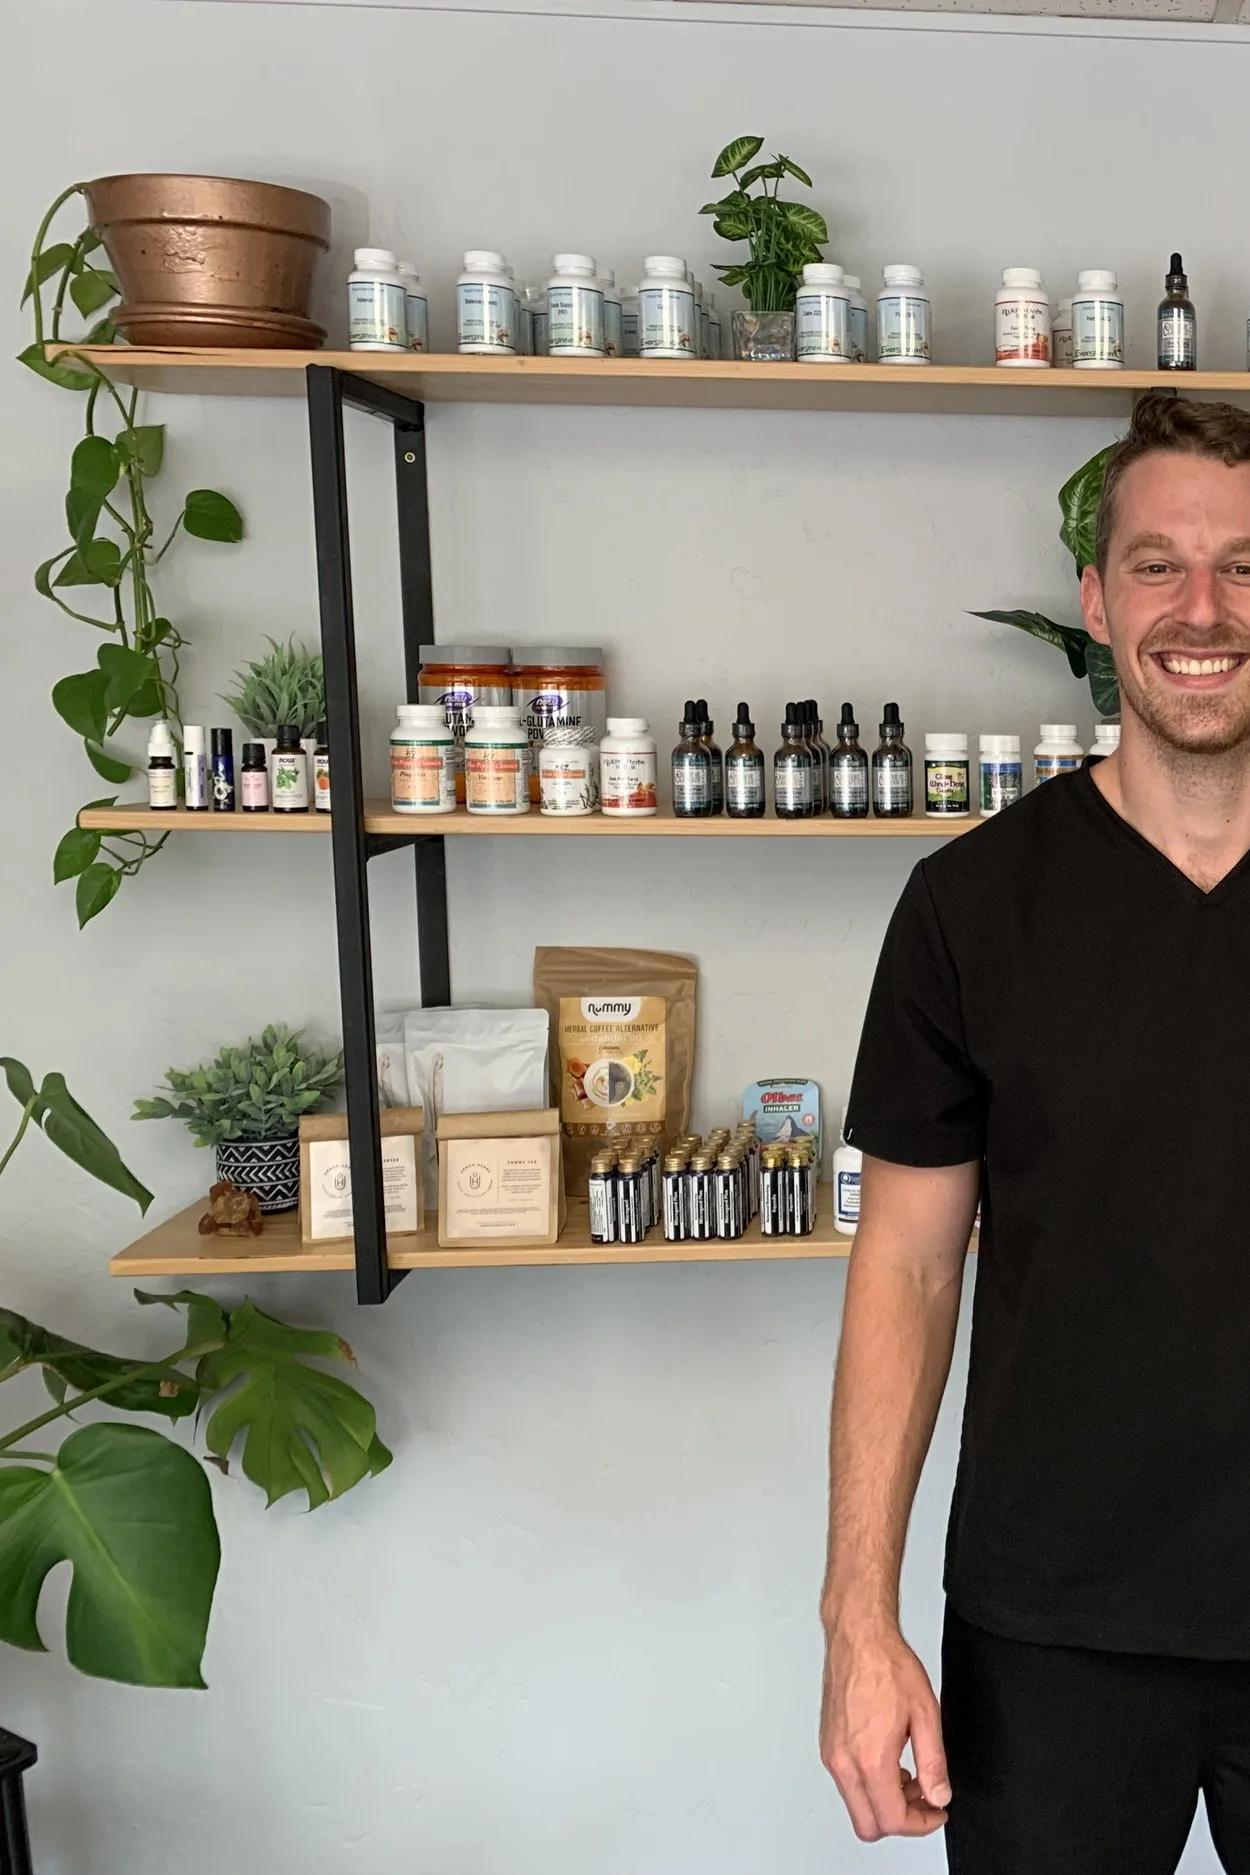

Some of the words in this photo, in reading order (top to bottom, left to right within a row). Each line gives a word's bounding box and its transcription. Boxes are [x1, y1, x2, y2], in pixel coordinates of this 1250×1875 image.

[565, 1025, 587, 1033] HERBAL
[590, 1024, 613, 1033] COFFEE
[616, 1023, 659, 1032] ALTERNATIVE
